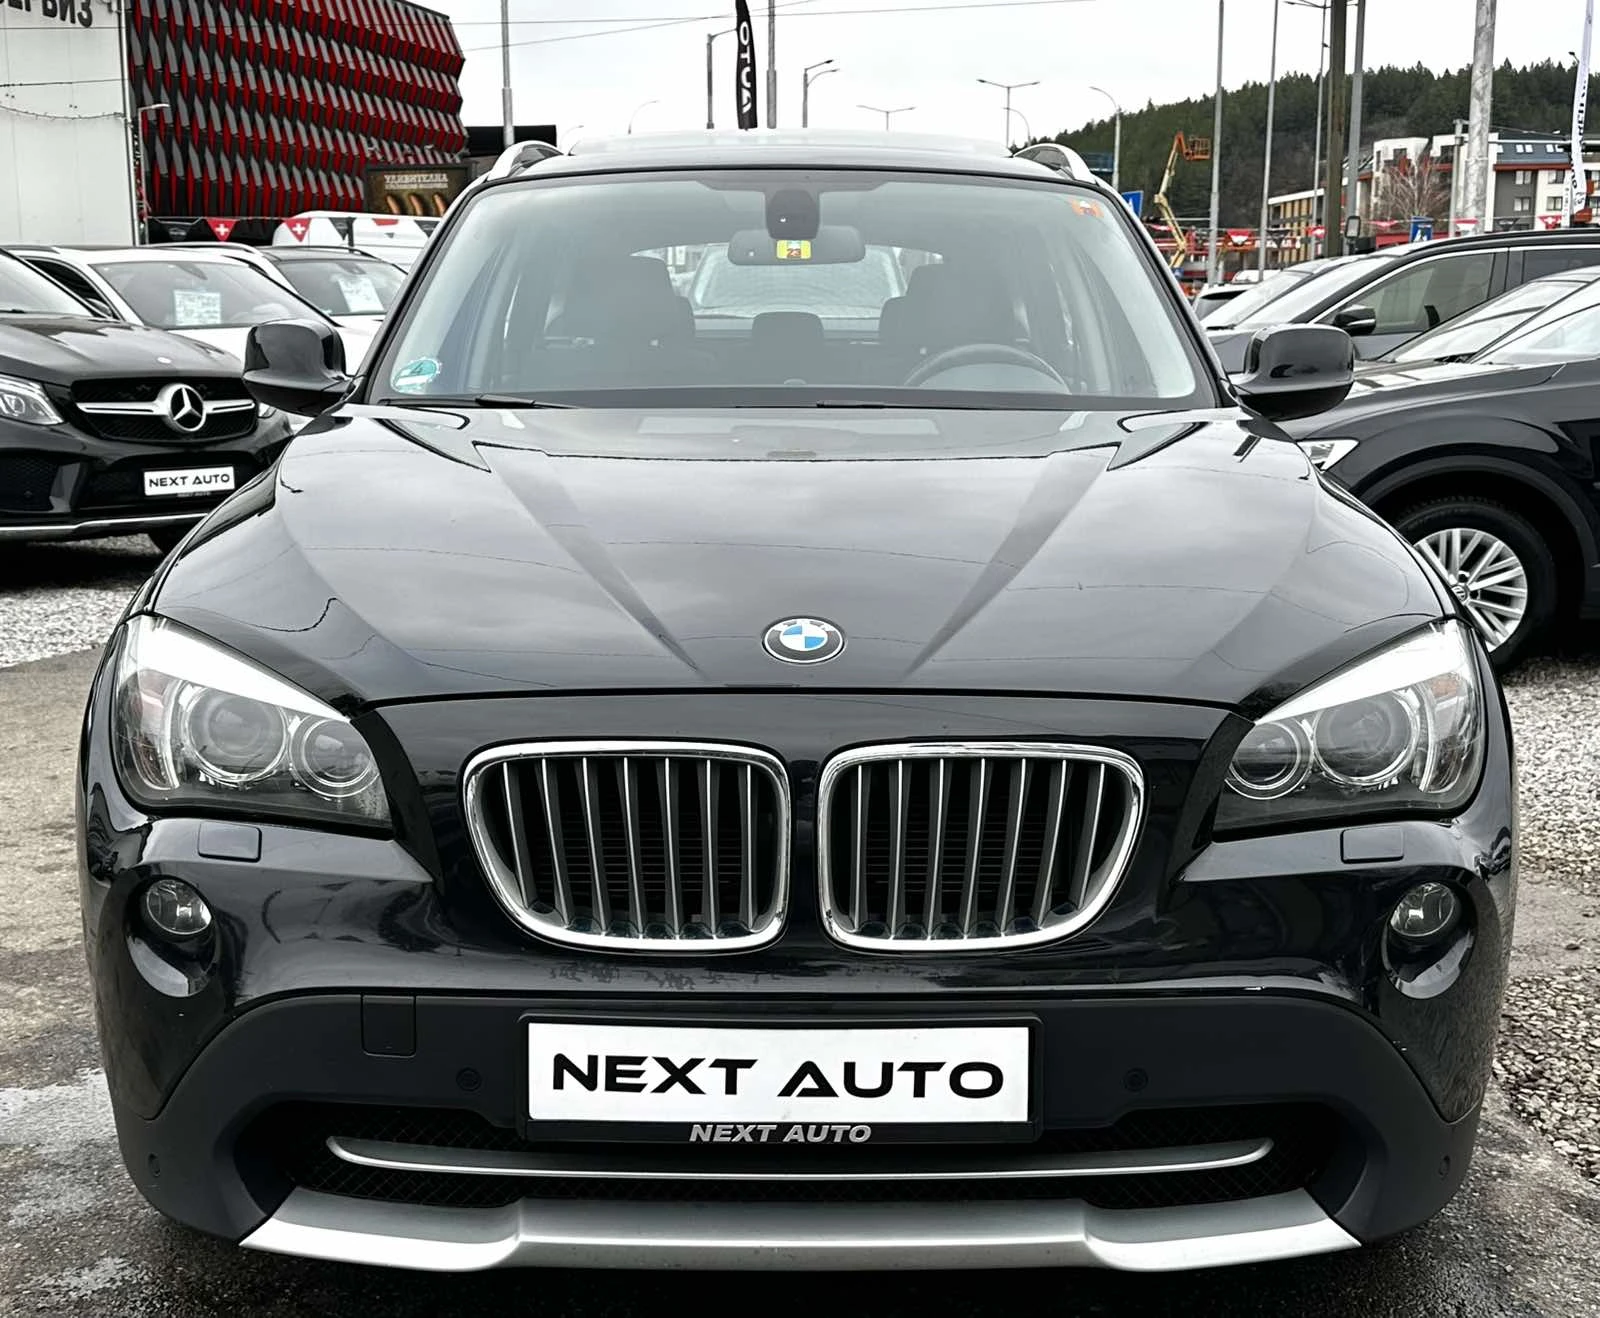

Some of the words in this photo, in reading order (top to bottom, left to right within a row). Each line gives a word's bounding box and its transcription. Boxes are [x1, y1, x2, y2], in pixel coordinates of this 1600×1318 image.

[149, 476, 188, 487] NEXT
[192, 474, 230, 485] AUTO
[552, 1053, 758, 1095] NEXT
[777, 1060, 1004, 1099] AUTO
[689, 1124, 782, 1143] NEXT
[783, 1124, 872, 1143] AUTO
